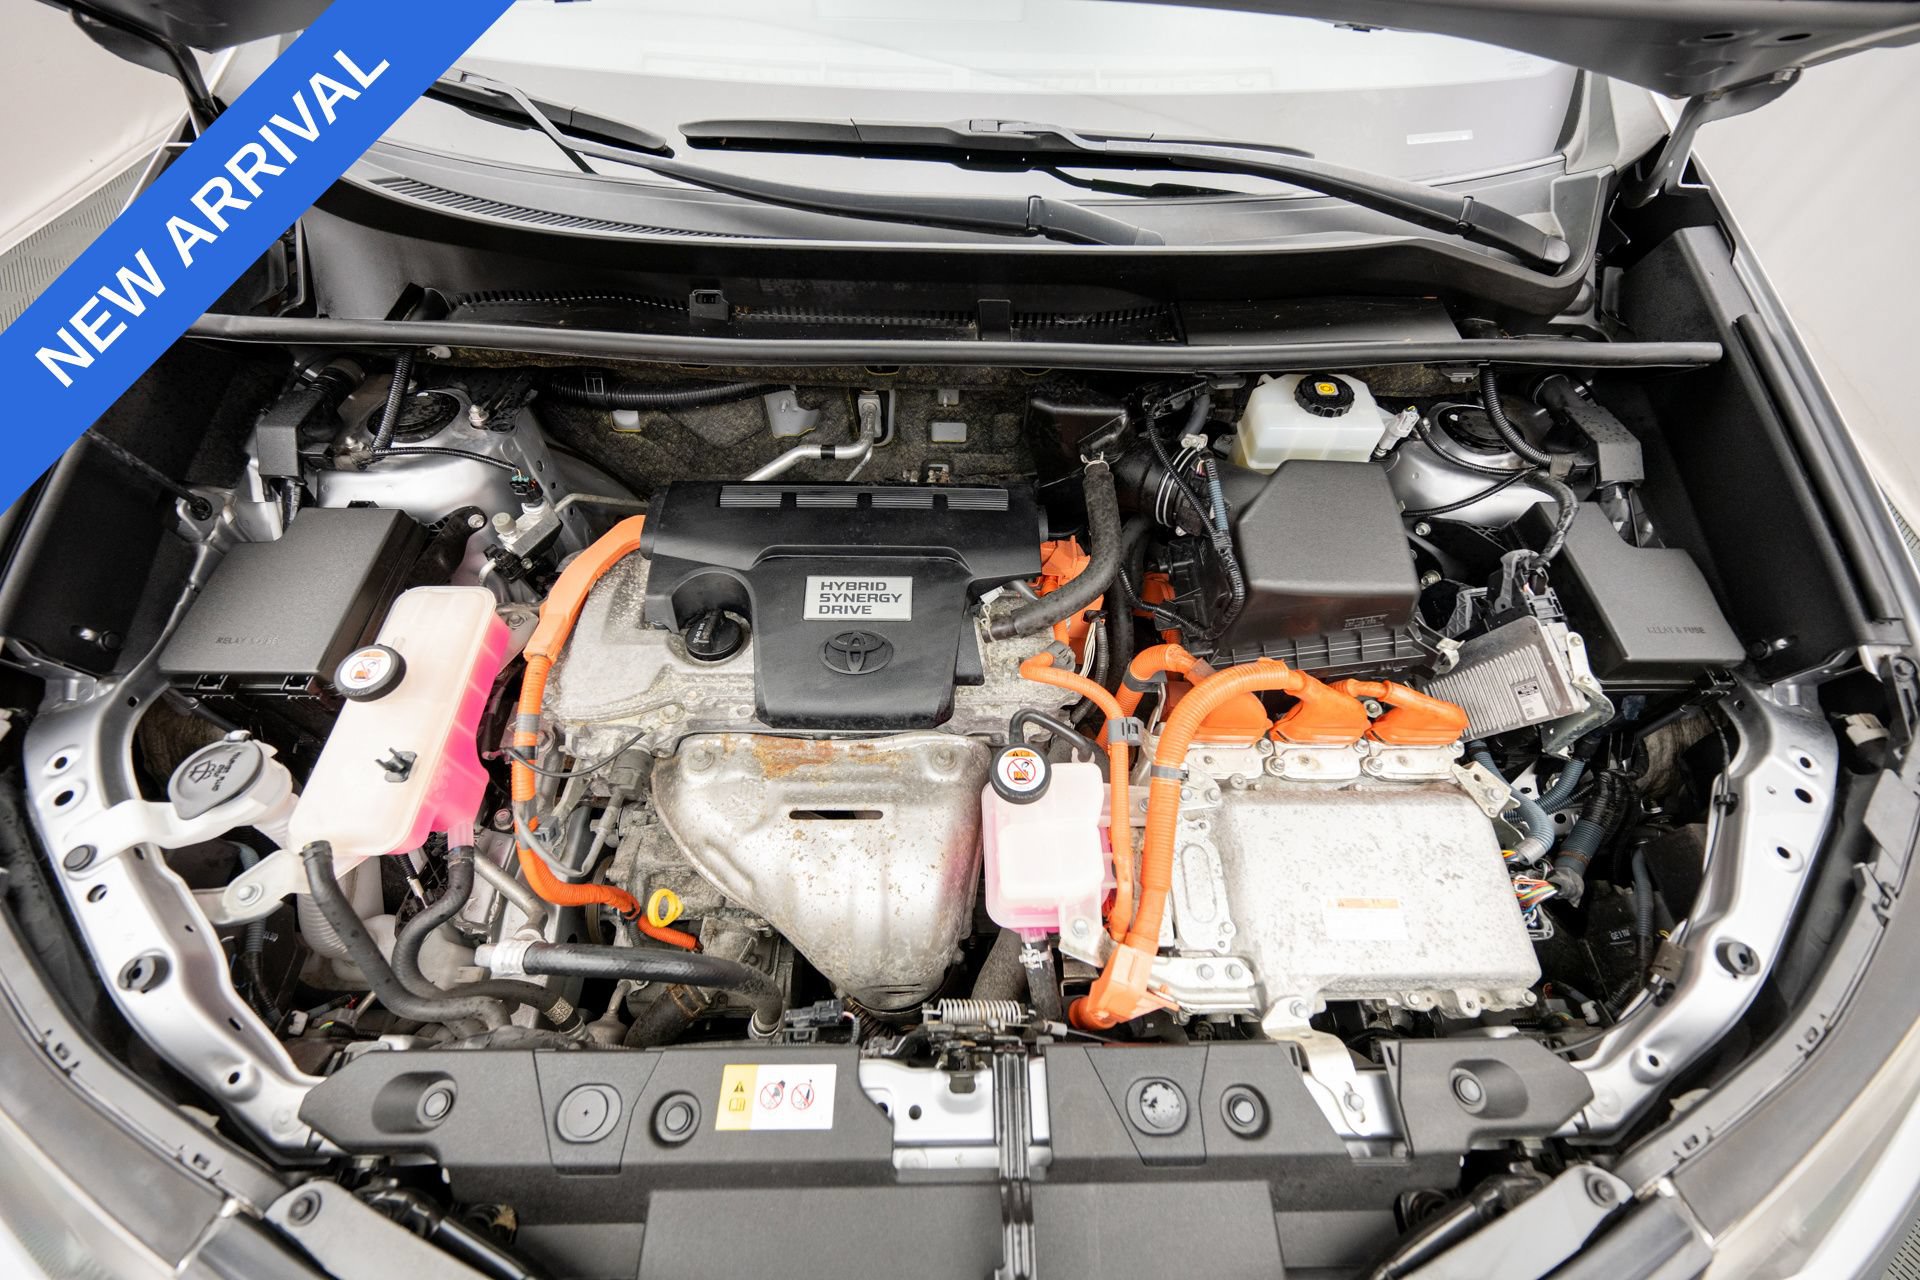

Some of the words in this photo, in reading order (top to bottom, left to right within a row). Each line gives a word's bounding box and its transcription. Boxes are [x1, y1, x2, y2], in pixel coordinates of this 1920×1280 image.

[820, 581, 887, 591] HYBRID
[819, 593, 903, 603] SYNERGY
[818, 605, 873, 615] DRIVE
